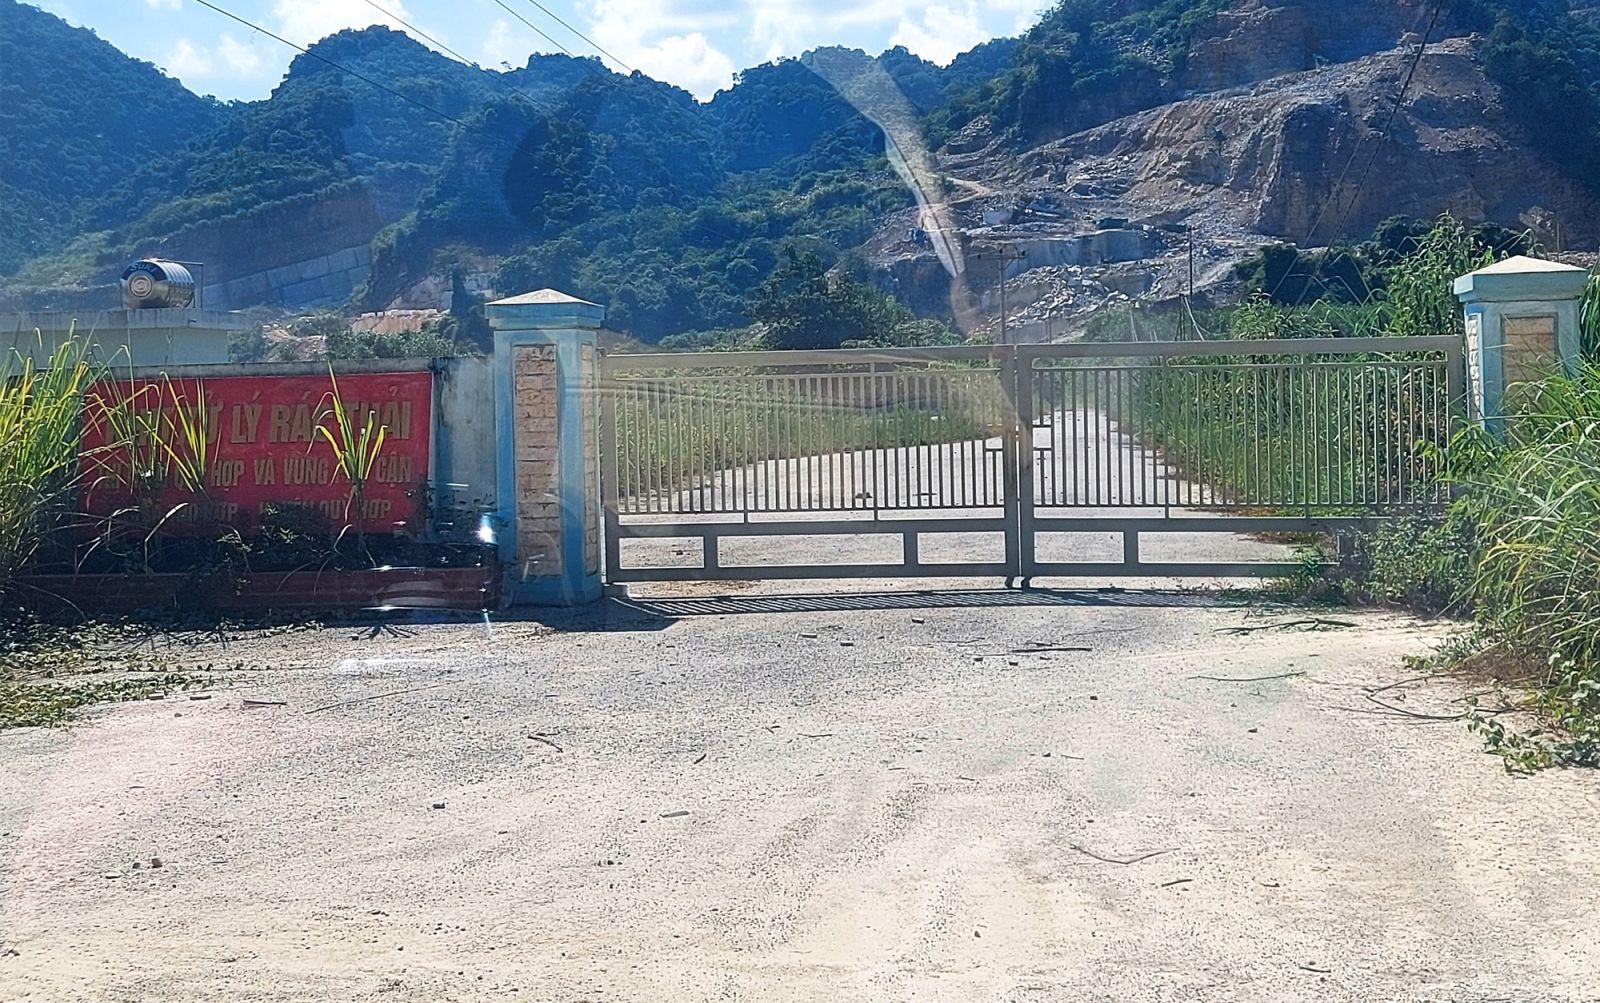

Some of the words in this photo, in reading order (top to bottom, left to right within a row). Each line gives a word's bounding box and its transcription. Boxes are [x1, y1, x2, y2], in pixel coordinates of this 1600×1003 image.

[231, 391, 263, 443] LÝ
[253, 451, 276, 485] VÀ
[283, 450, 328, 485] VÙNG
[375, 451, 412, 488] CẬN
